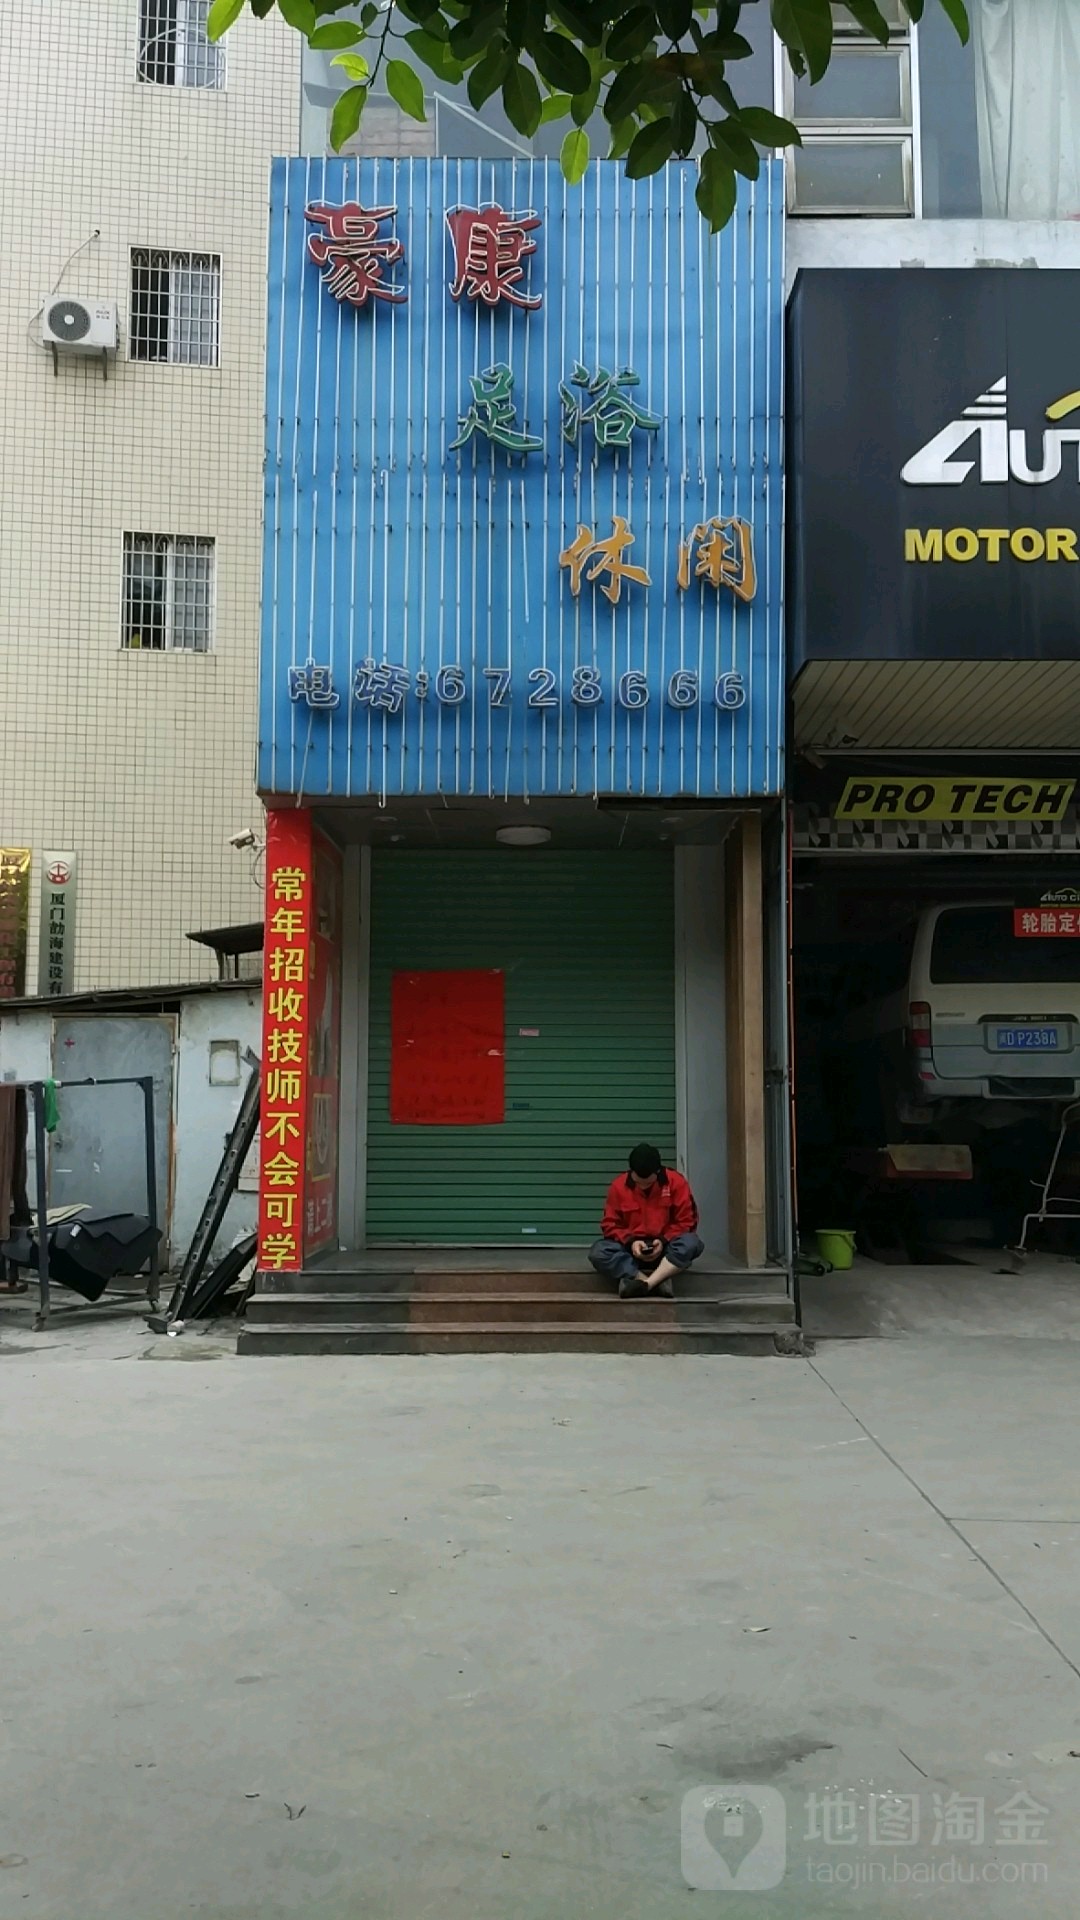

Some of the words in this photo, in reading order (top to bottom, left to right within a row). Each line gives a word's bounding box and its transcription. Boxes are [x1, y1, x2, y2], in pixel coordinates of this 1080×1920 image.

[304, 200, 544, 309] 豪康
[449, 360, 661, 450] 足浴
[559, 515, 757, 602] 休闲
[904, 527, 1080, 563] MOTOR
[843, 784, 936, 814] PRO
[950, 785, 1069, 815] TECH
[1022, 912, 1080, 934] 轮胎定
[261, 866, 306, 1270] 常年招收技师不会可学
